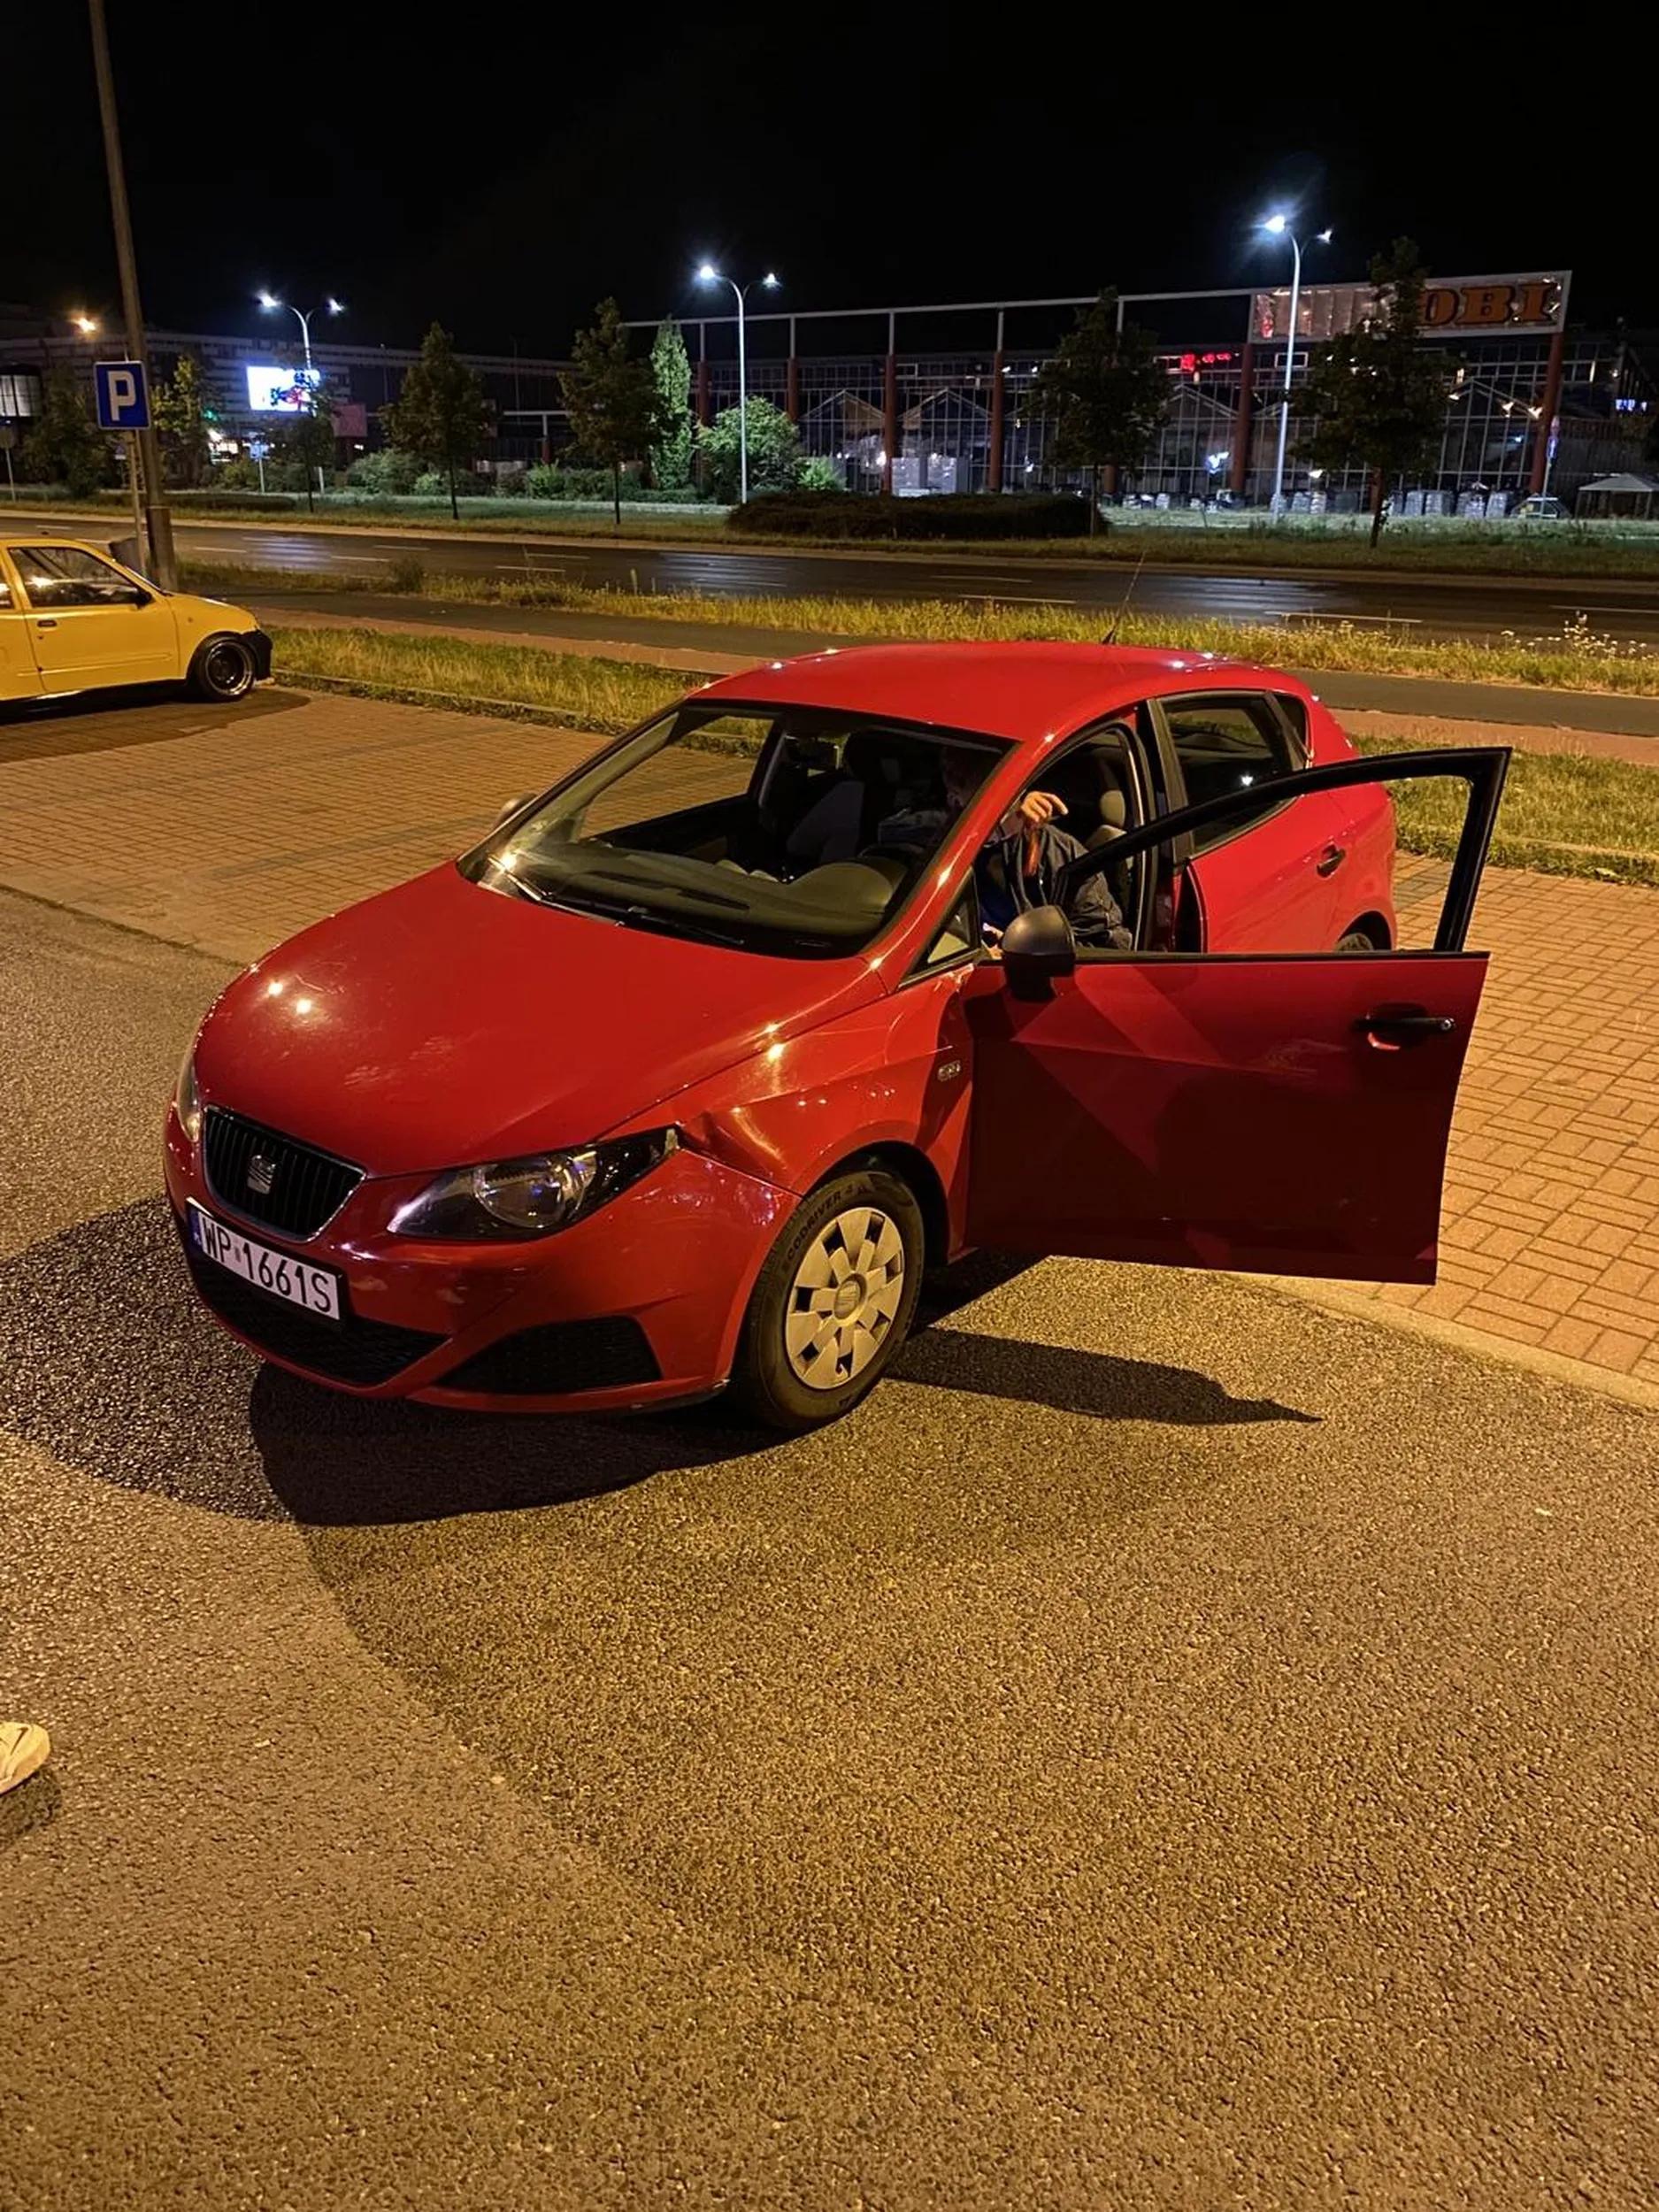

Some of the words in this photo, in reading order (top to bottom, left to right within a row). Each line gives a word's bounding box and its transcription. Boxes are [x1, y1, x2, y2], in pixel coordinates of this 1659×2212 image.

[1418, 283, 1554, 326] OBI
[107, 370, 136, 421] P
[202, 1217, 231, 1263] WP
[242, 1242, 332, 1314] 1661S
